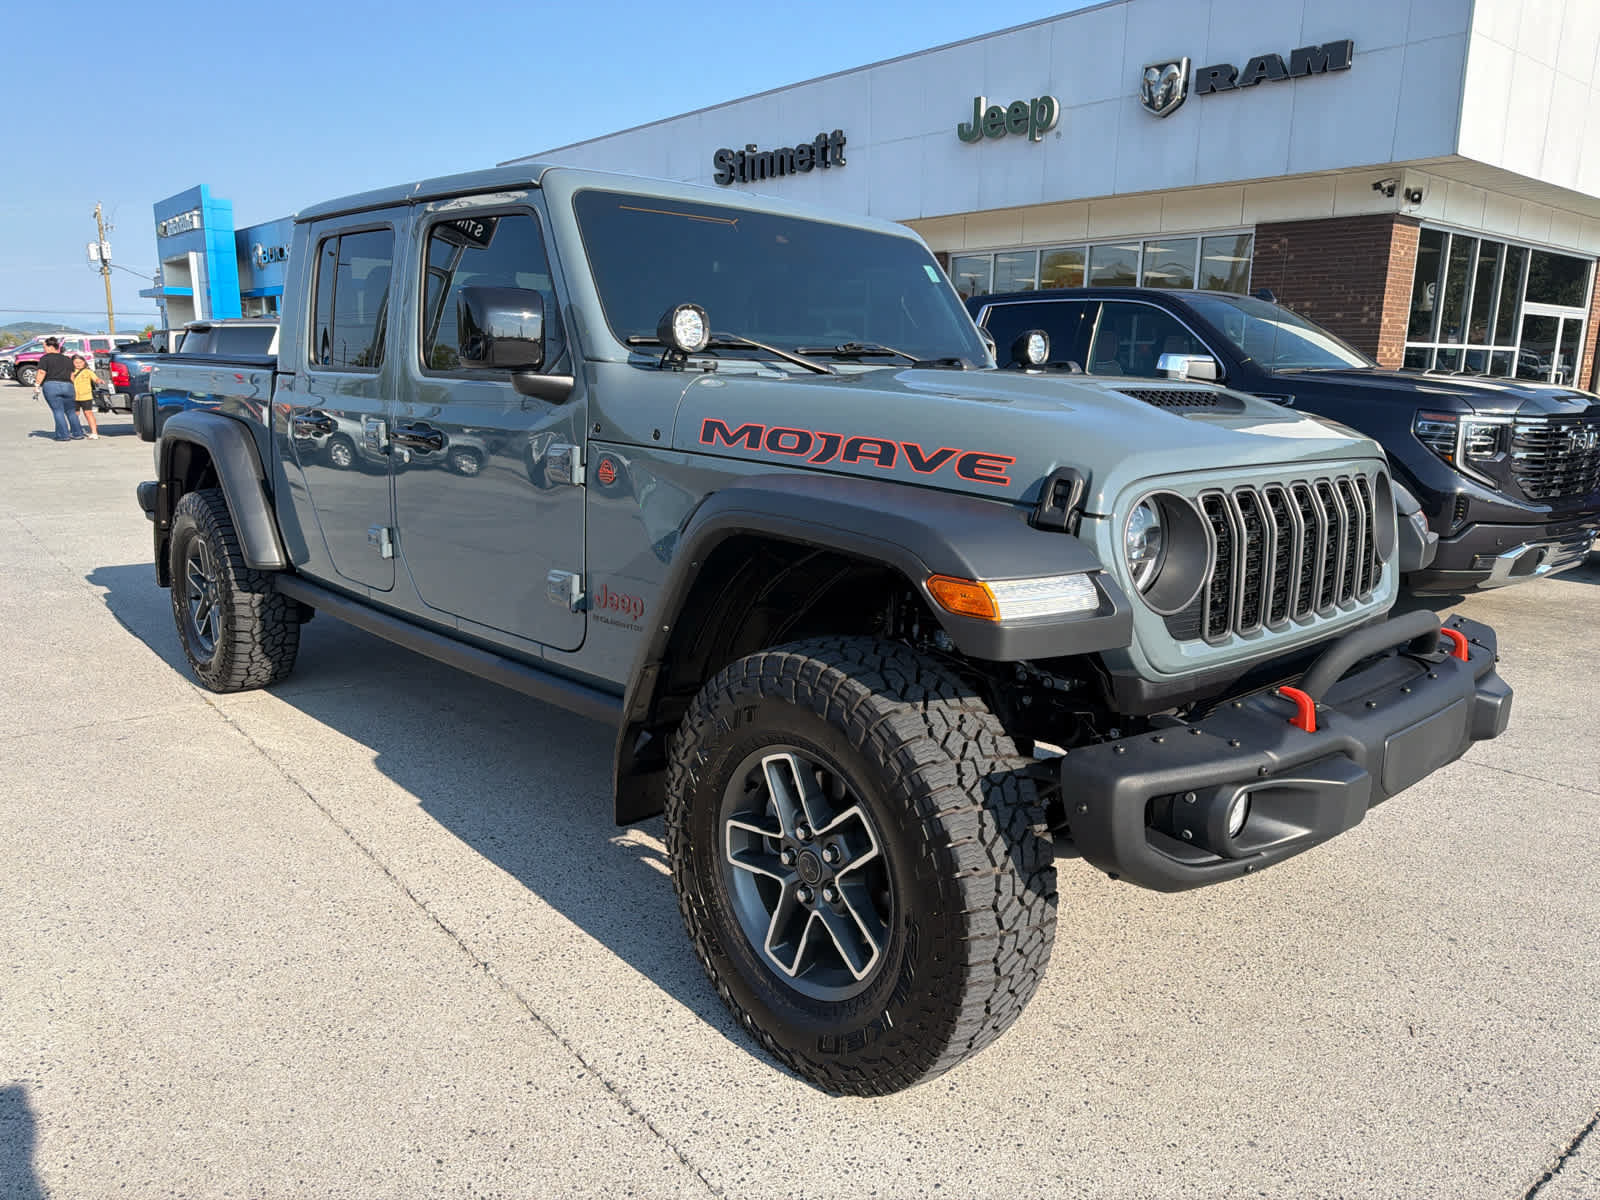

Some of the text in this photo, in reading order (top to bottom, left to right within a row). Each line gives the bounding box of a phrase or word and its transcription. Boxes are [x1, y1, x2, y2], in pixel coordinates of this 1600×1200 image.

[1195, 39, 1354, 96] RAM
[957, 95, 1061, 144] Jeep
[713, 129, 848, 186] Stinnett
[699, 418, 1017, 486] MOJAVE
